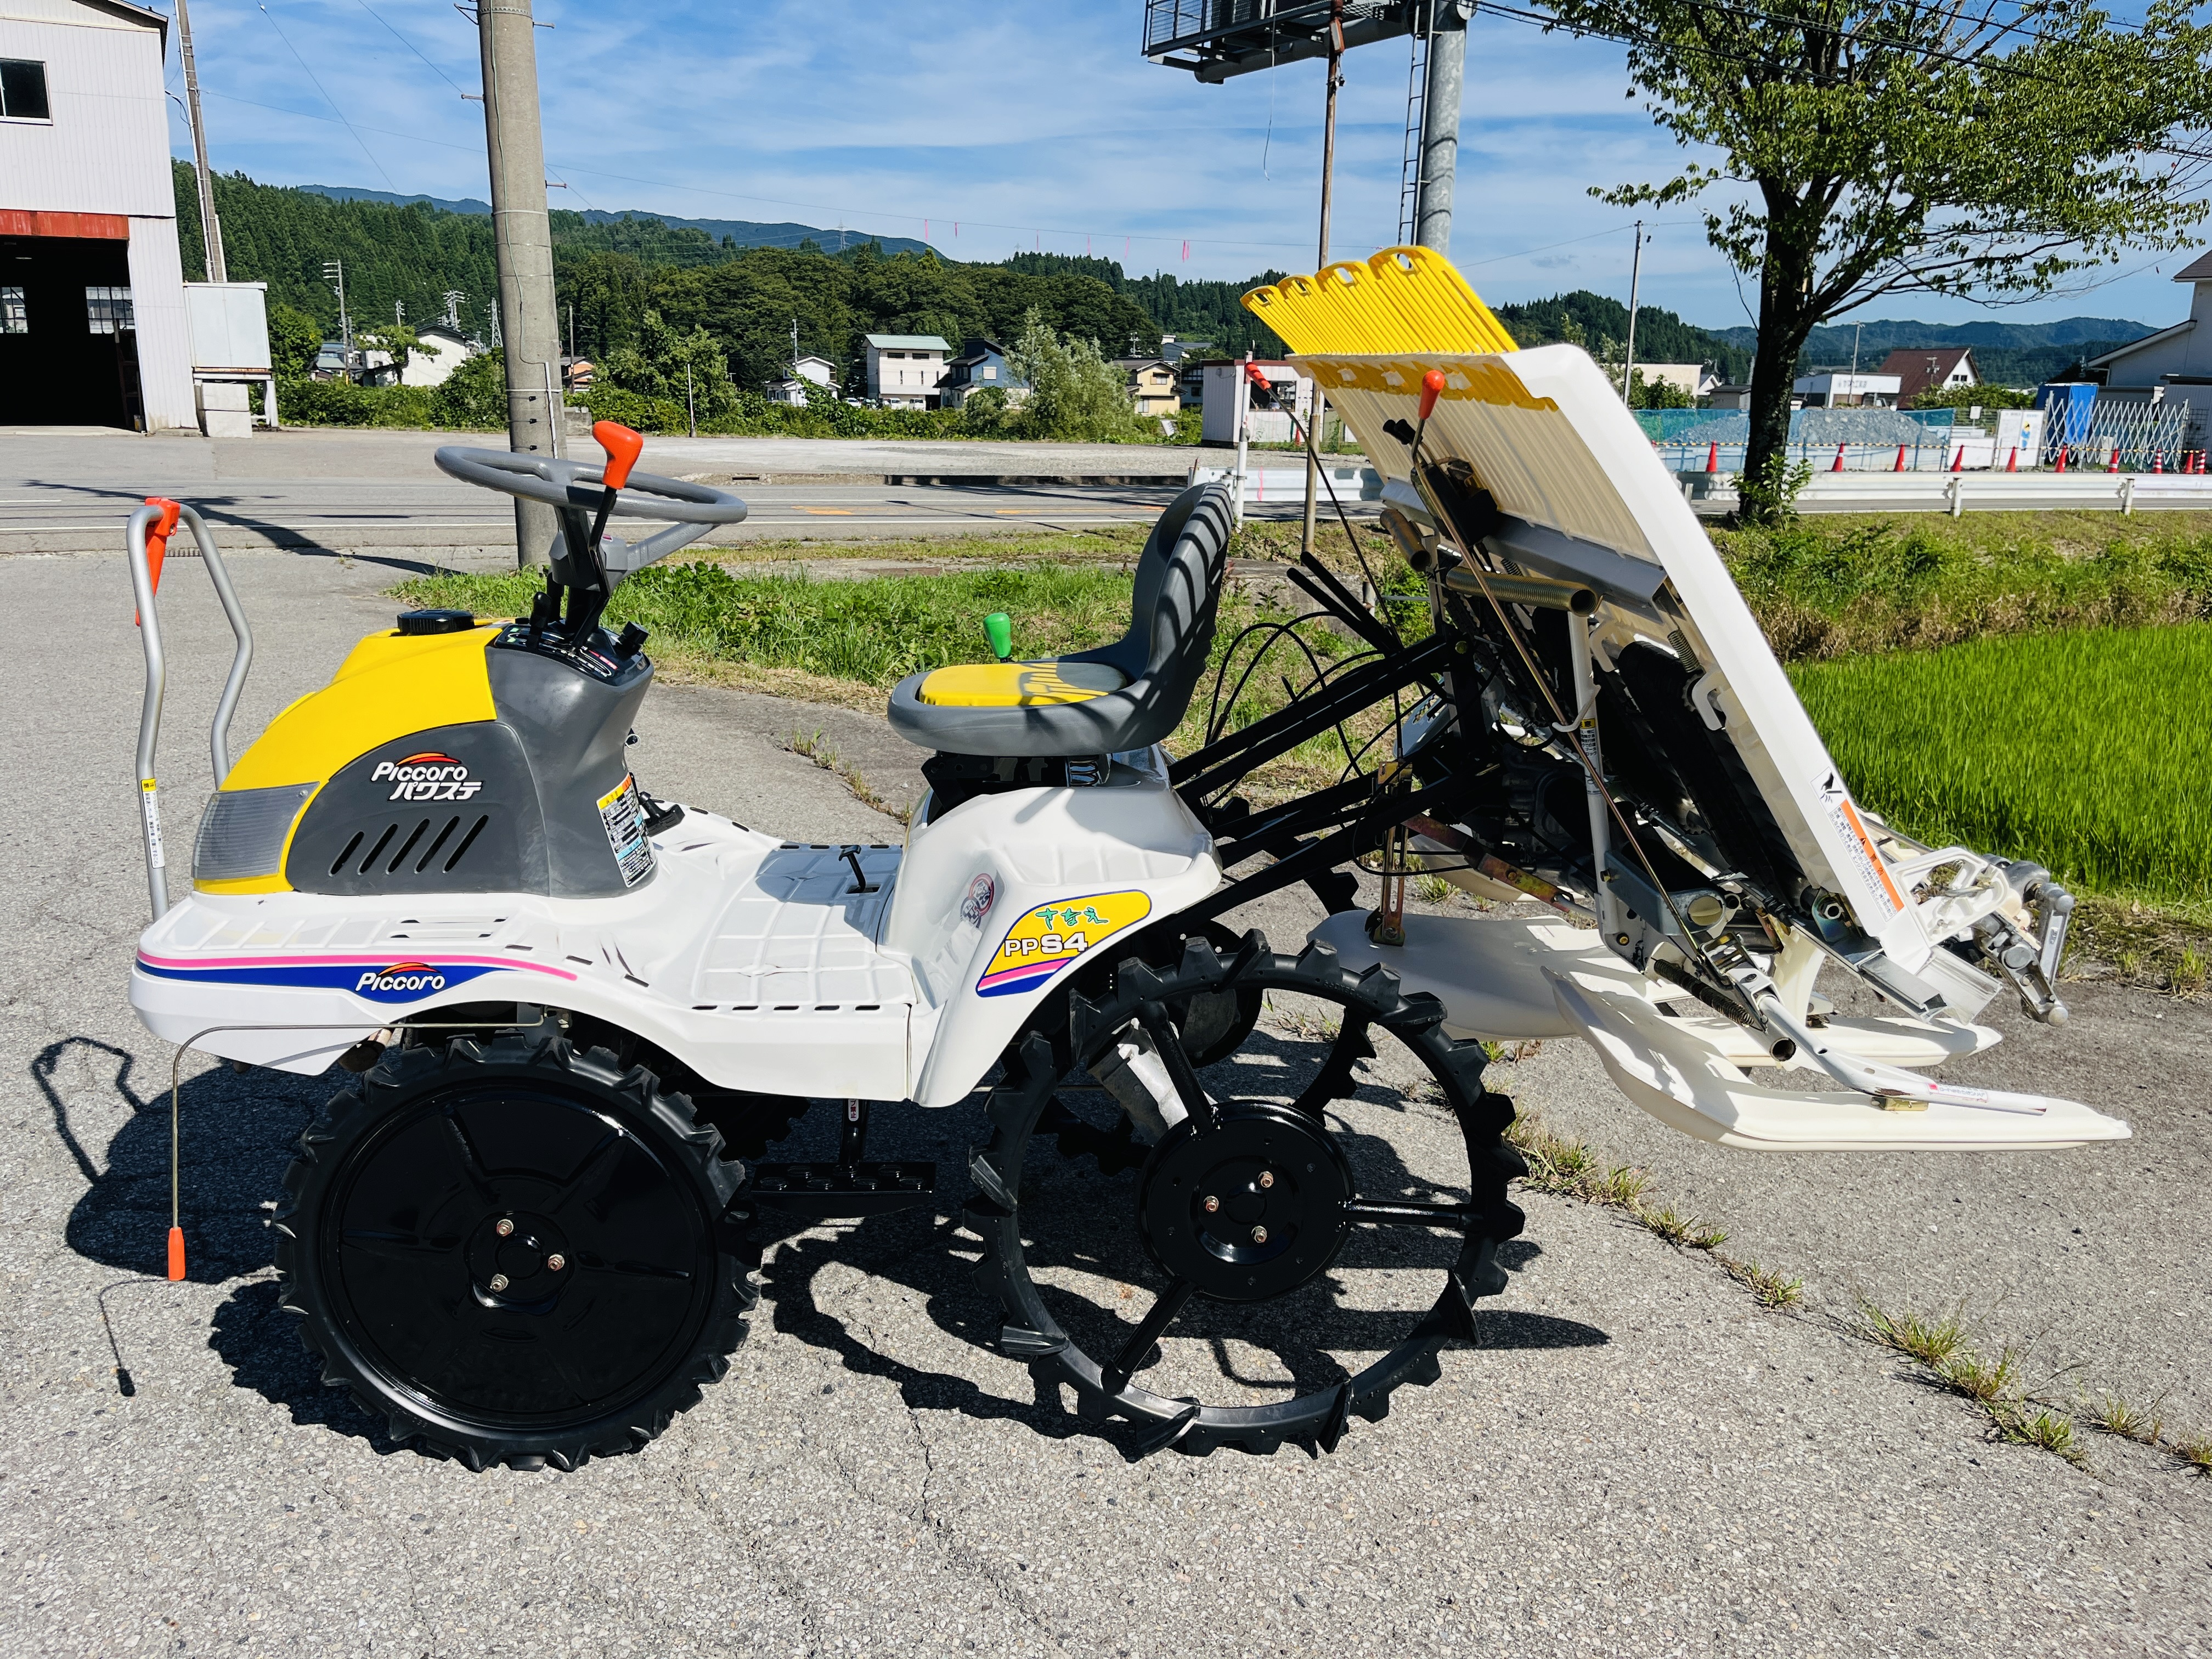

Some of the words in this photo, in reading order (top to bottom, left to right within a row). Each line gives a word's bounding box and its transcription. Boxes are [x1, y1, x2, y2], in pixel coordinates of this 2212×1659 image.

[388, 782, 482, 800] パワステ
[1035, 907, 1109, 930] さなえ
